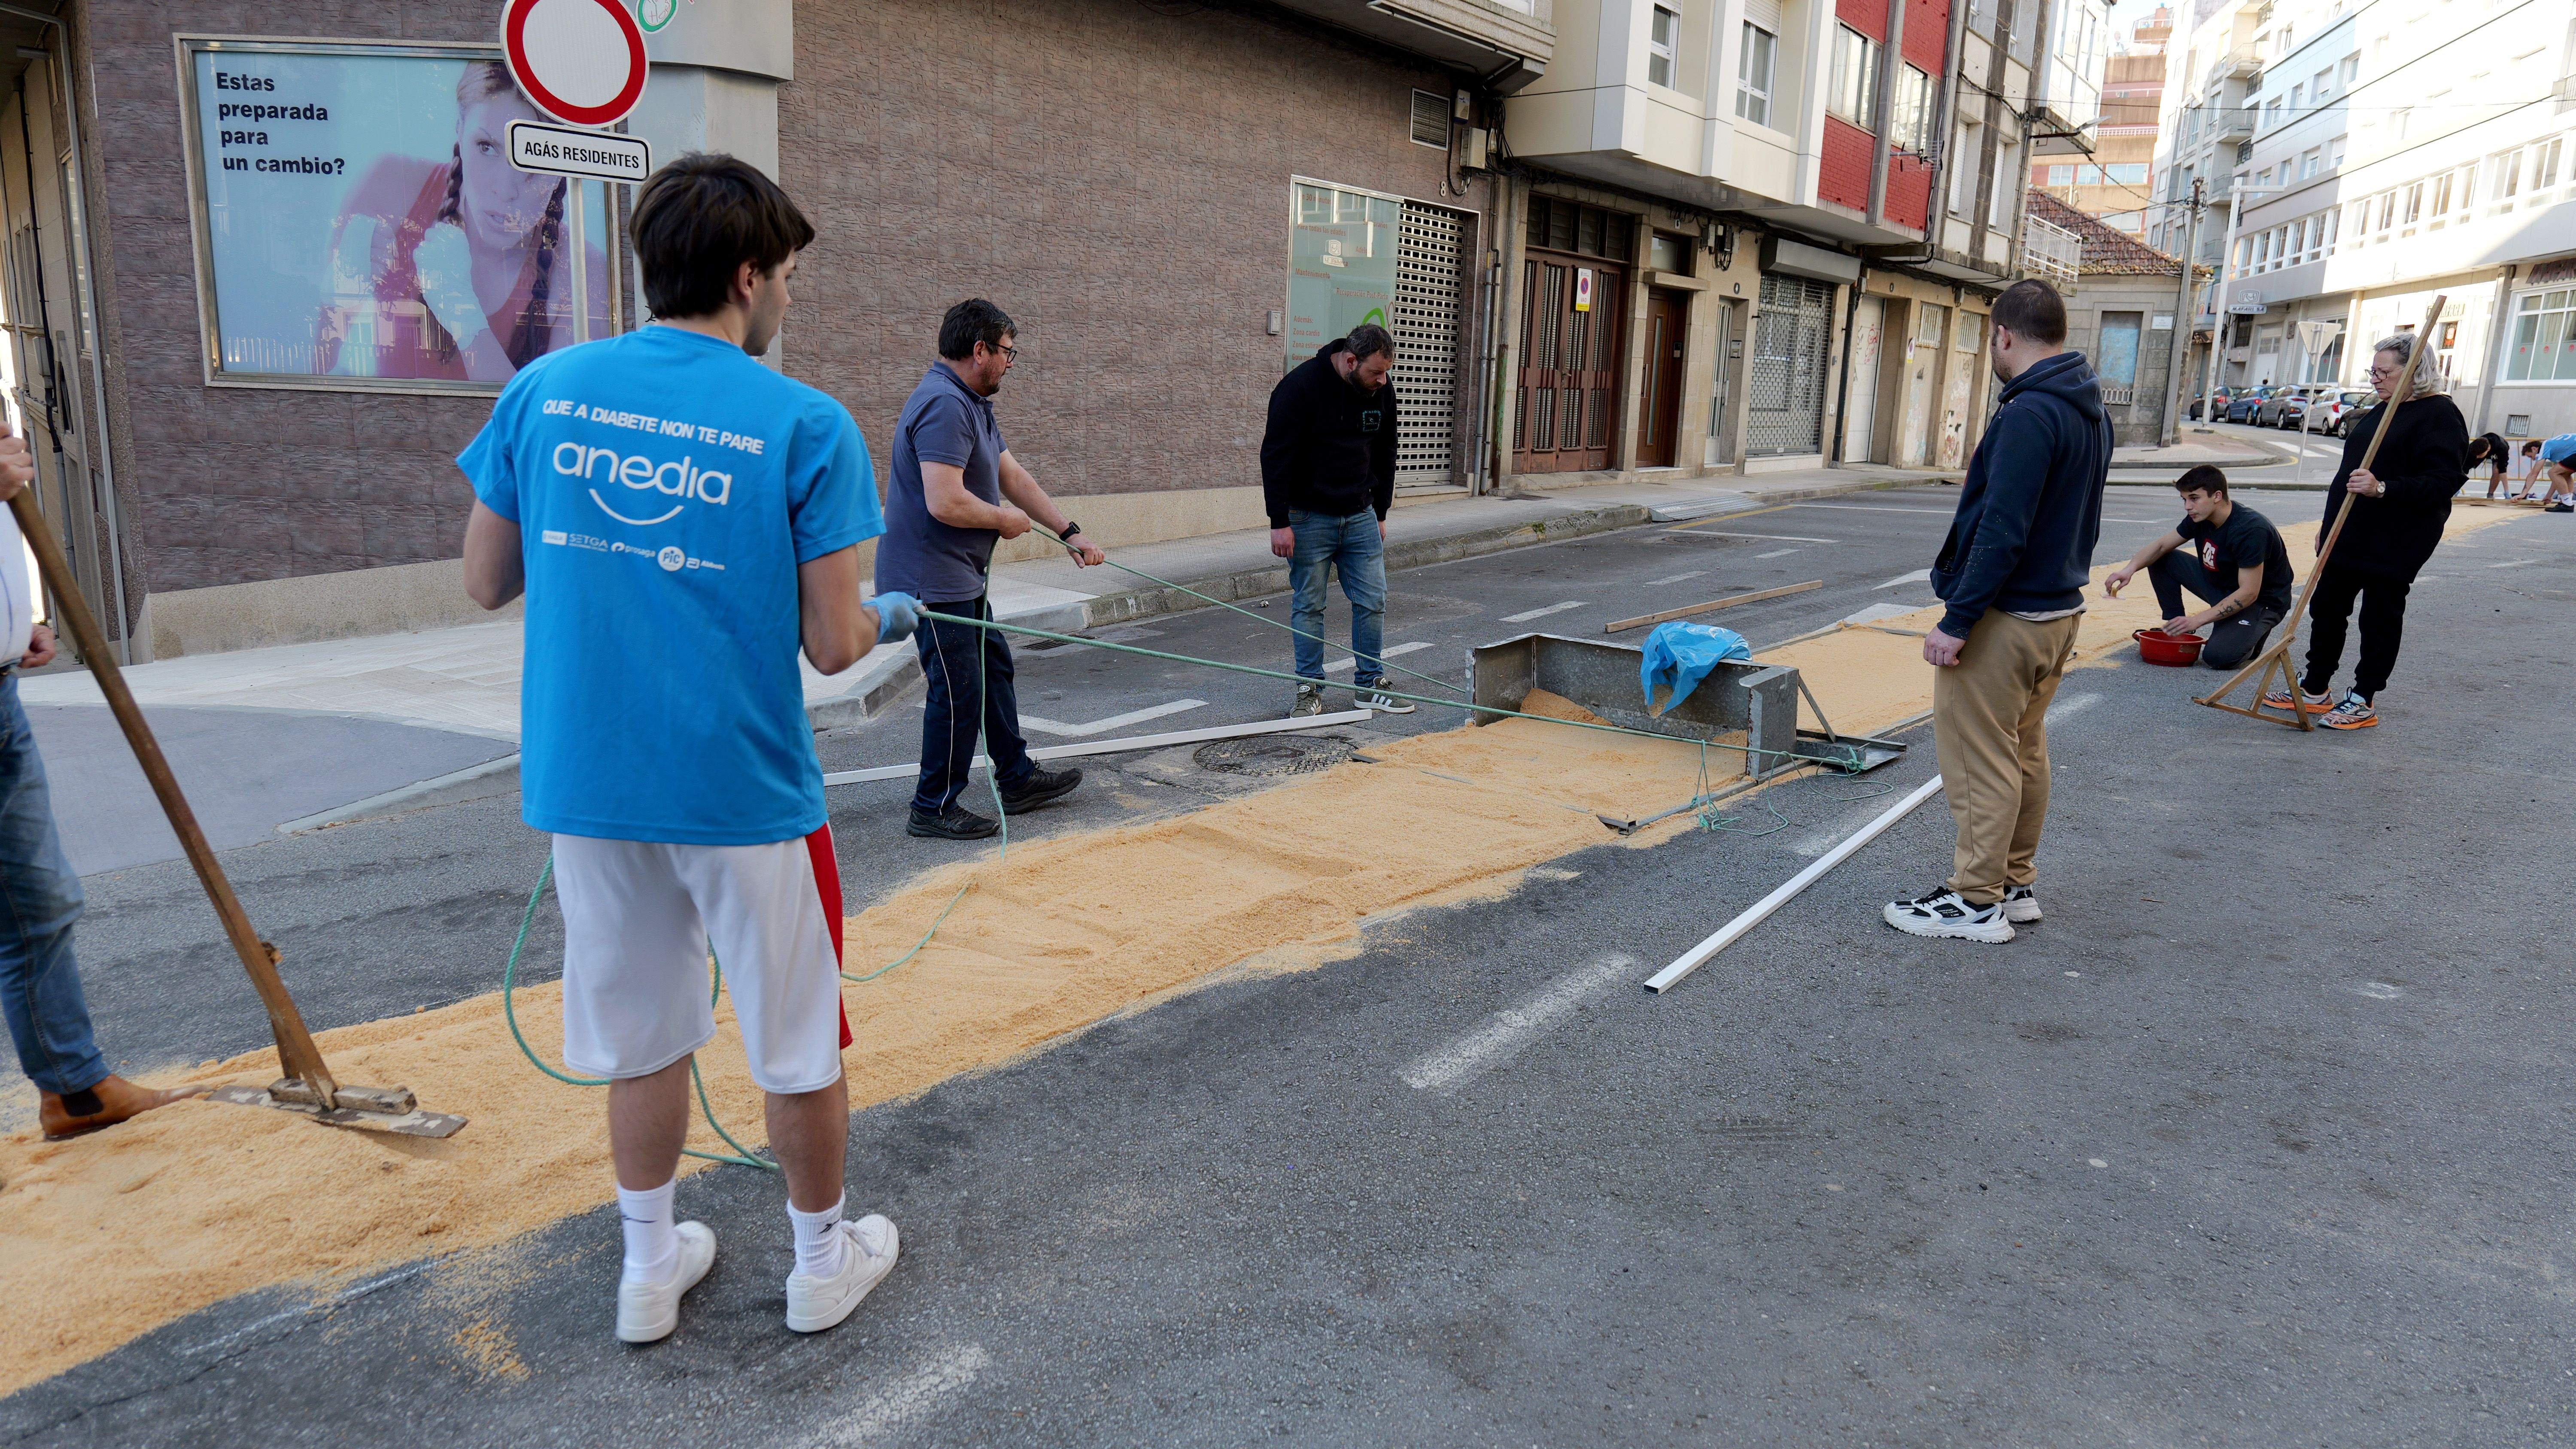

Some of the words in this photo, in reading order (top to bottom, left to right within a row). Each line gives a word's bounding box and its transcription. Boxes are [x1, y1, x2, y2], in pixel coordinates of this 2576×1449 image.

[216, 72, 275, 91] Estas
[219, 103, 328, 122] preparada
[221, 130, 268, 148] para
[525, 141, 558, 158] AGÁS
[563, 146, 639, 168] RESIDENTES
[223, 157, 248, 170] un
[256, 157, 344, 175] cambio?
[1440, 181, 1446, 197] 8
[1309, 224, 1321, 233] todas
[1331, 228, 1346, 236] edades
[1295, 268, 1331, 279] Mantenimiento
[1336, 288, 1366, 297] Recuperación
[1367, 291, 1388, 300] Post-Parto
[543, 399, 574, 415] QUE
[574, 403, 587, 419] A
[590, 407, 659, 433] DIABETE
[659, 420, 695, 439] NON
[697, 426, 719, 444] TE
[719, 431, 765, 455] PARE
[553, 442, 732, 506] anedia
